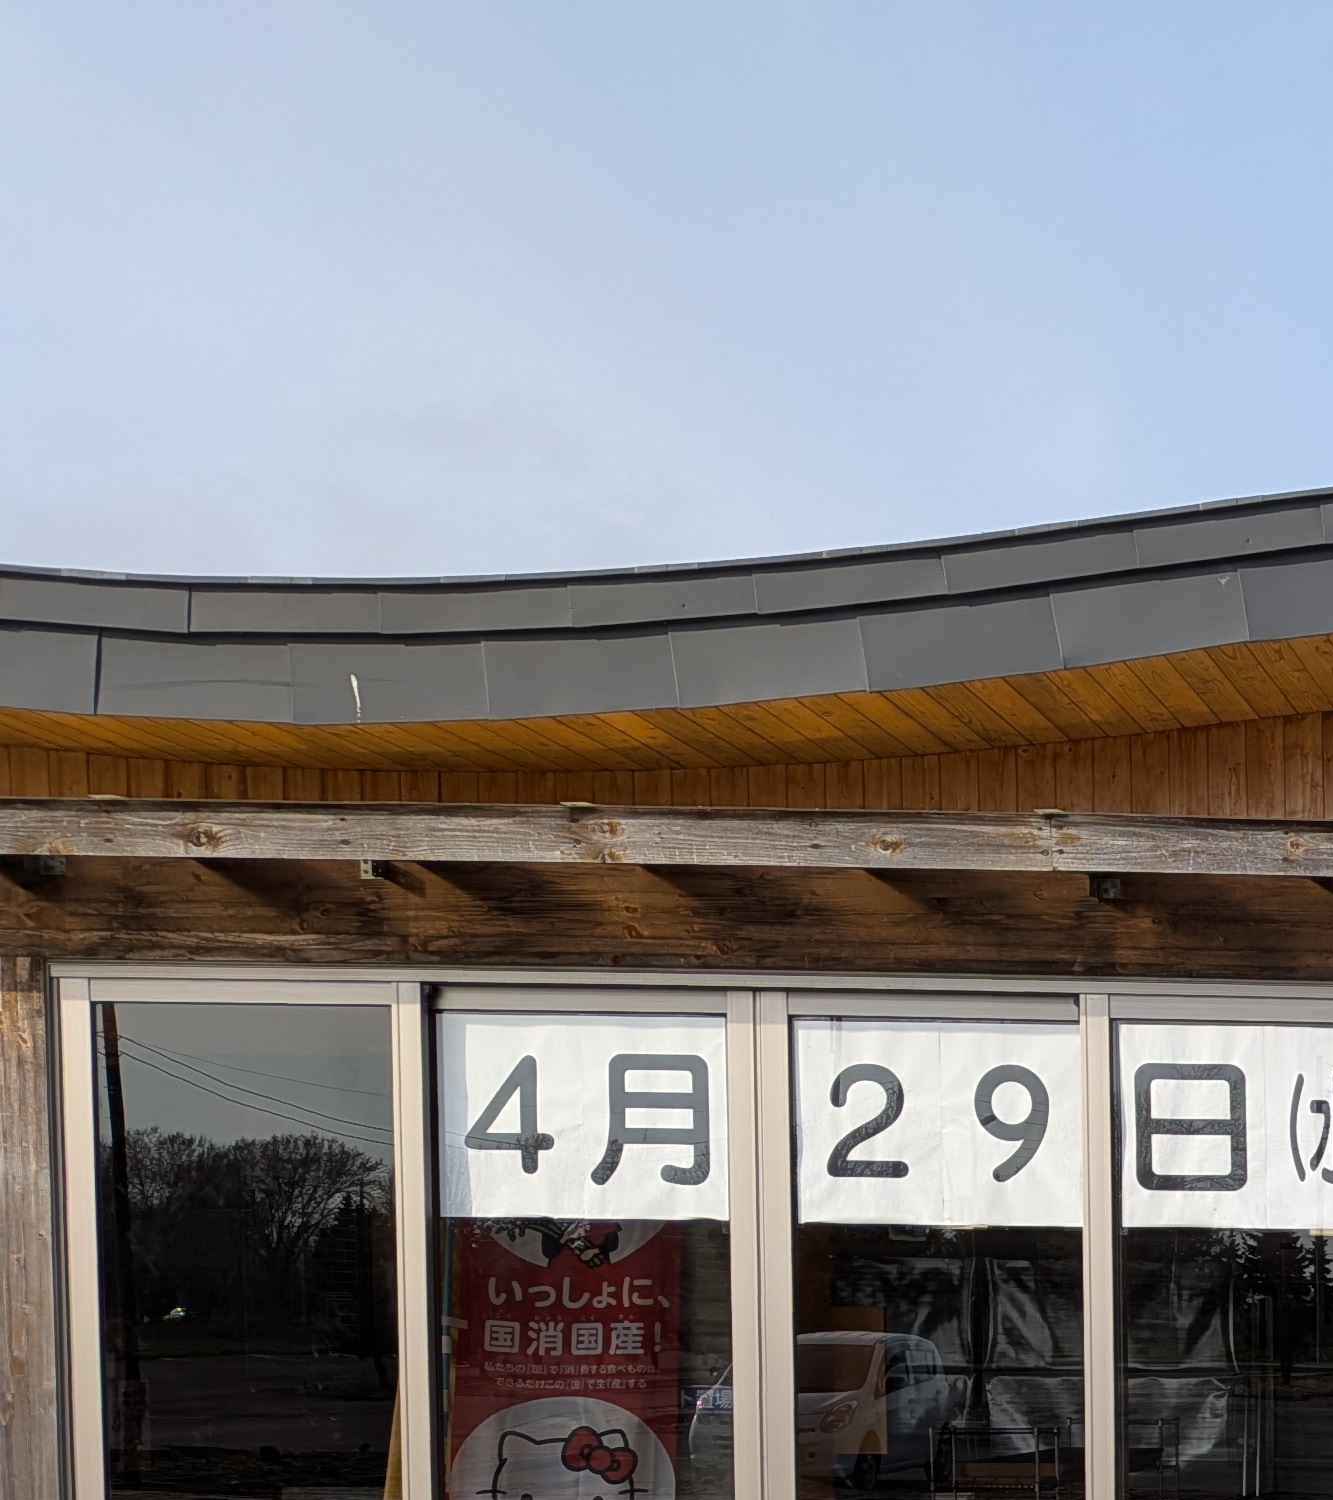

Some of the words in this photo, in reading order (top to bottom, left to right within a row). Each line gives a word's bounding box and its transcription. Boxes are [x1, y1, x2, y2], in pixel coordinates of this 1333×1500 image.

[487, 1275, 671, 1309] いっしょに、
